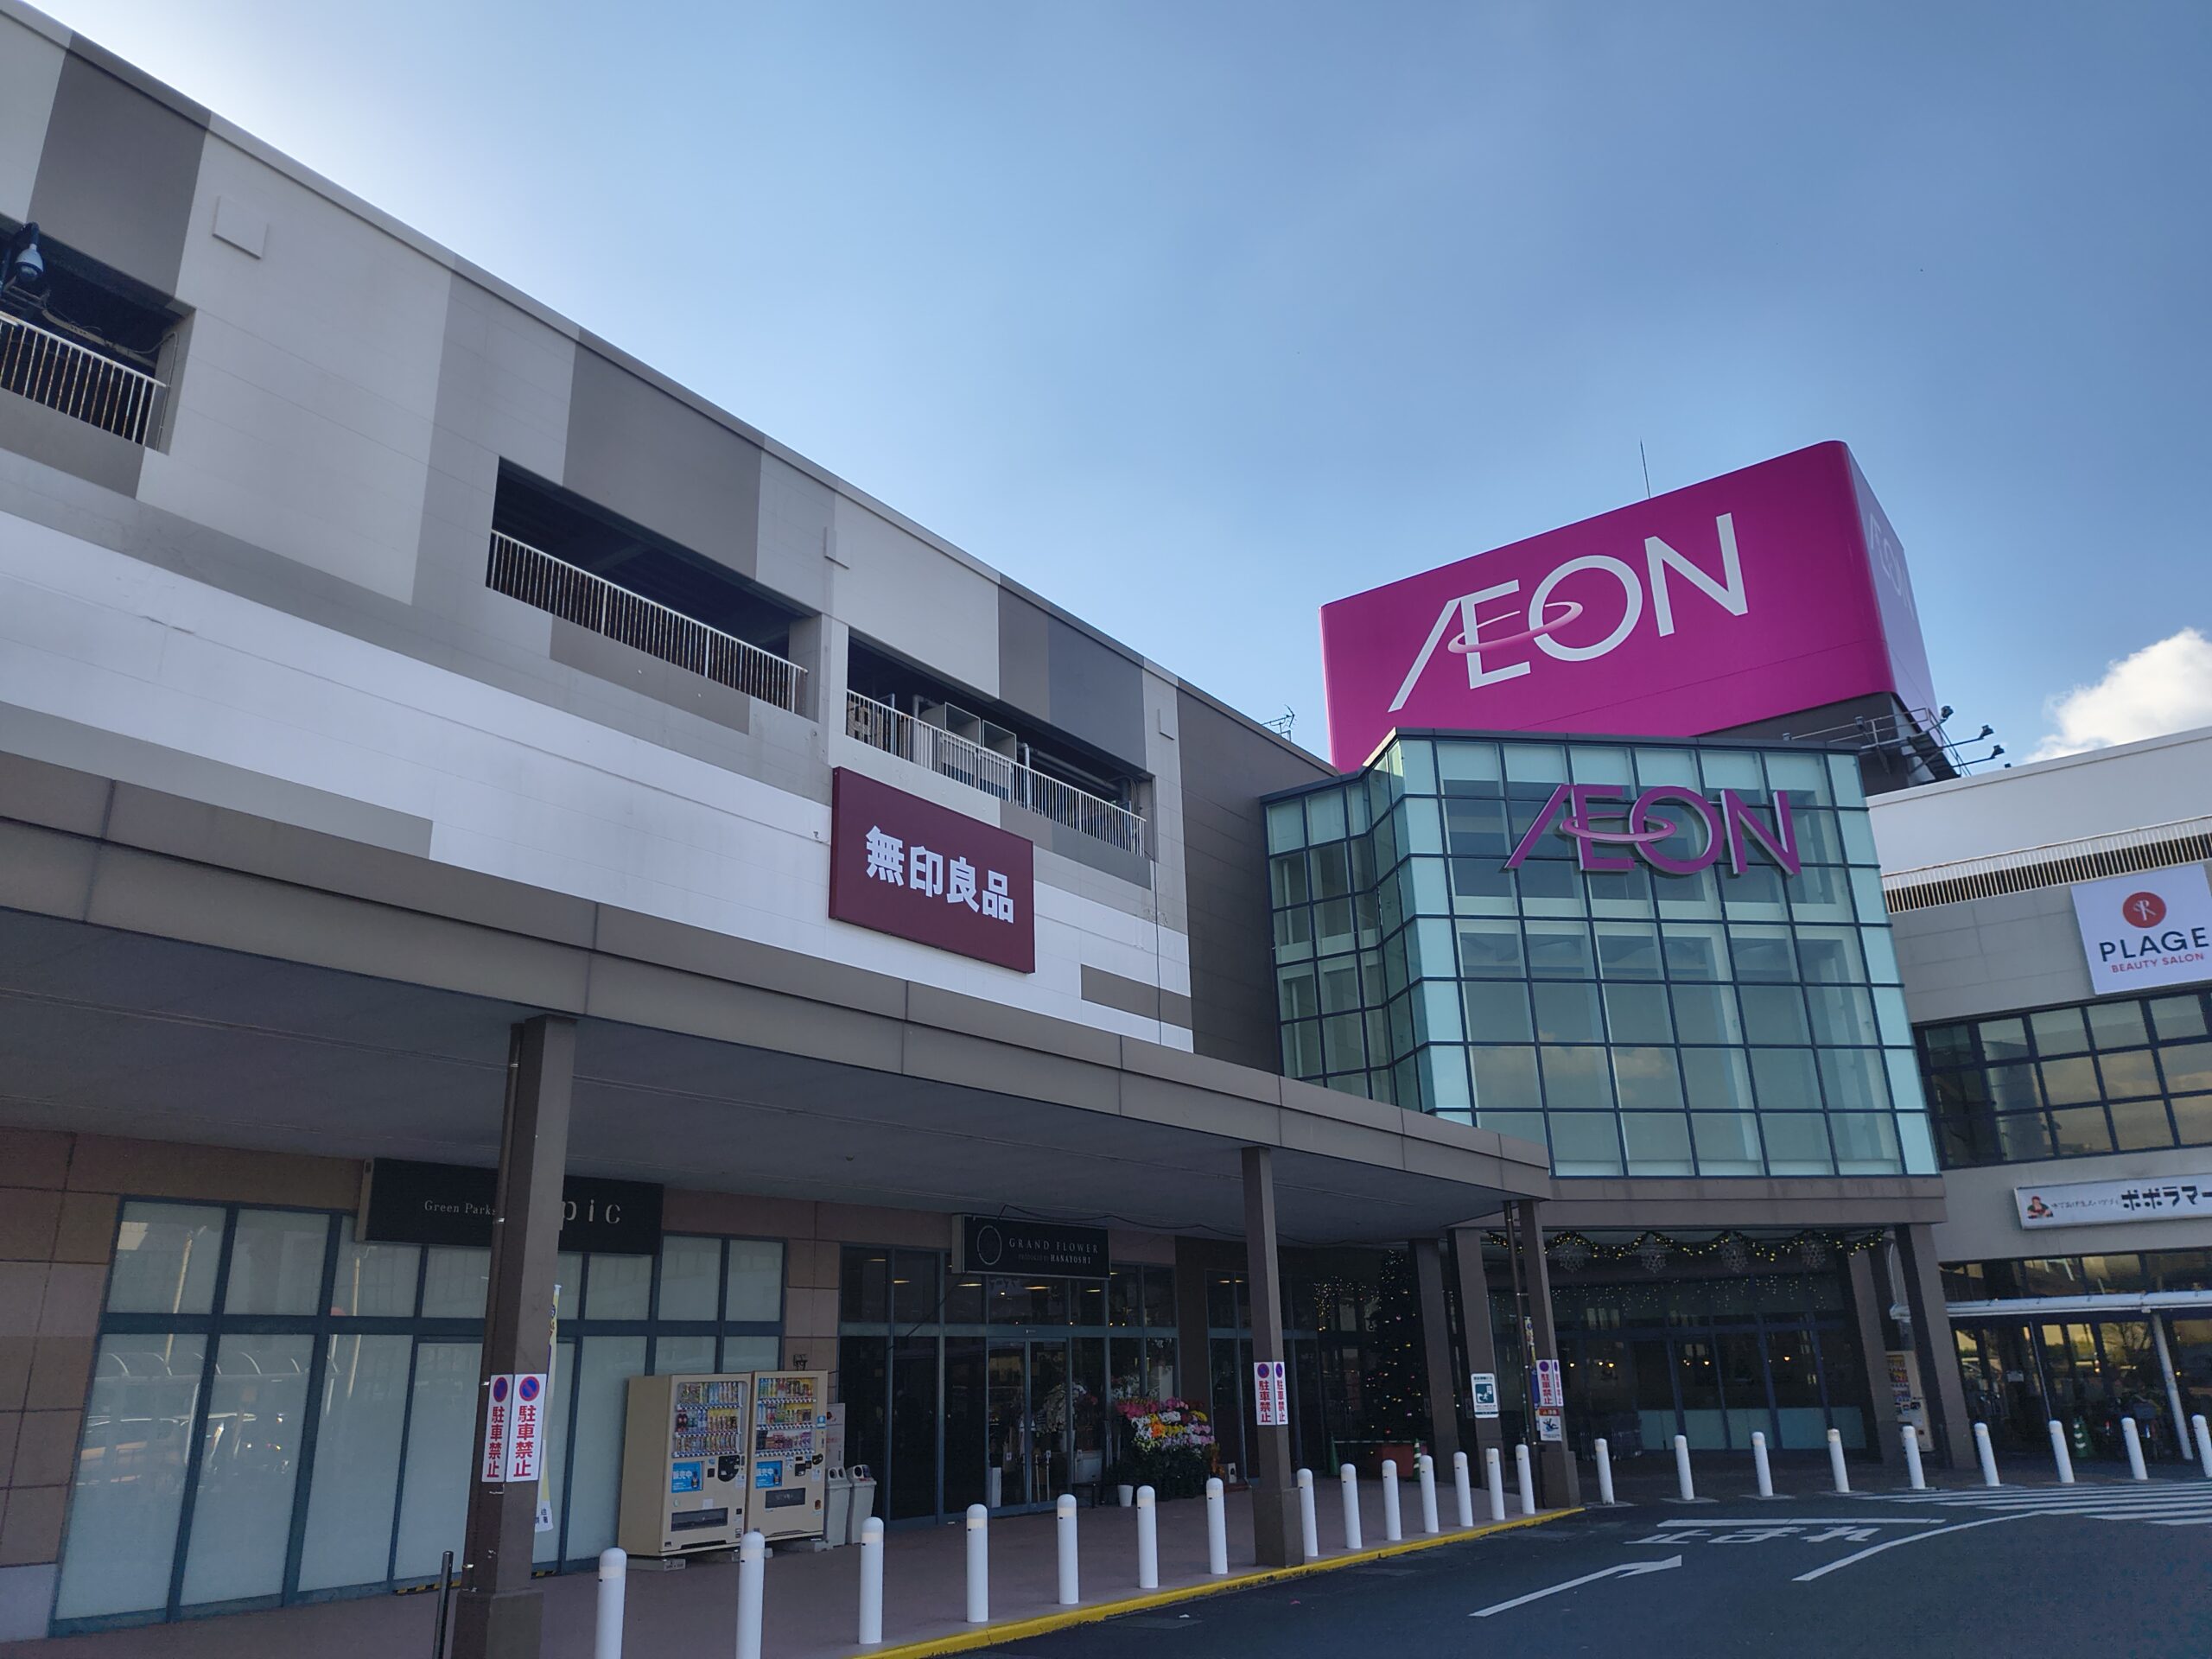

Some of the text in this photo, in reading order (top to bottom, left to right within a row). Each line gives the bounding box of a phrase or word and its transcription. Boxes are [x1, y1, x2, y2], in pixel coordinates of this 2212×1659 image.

[866, 825, 1014, 924] 無印良品
[2099, 927, 2209, 962] PLAGE
[2111, 953, 2205, 973] BEAUTY SALON
[424, 1199, 497, 1216] Green Parks
[1008, 1237, 1099, 1254] GRAND FLOWER
[1050, 1254, 1091, 1265] HANAYOSHI
[1259, 1380, 1271, 1423] 駐車禁止
[1277, 1380, 1286, 1422] 駐車禁止
[486, 1406, 505, 1478] 駐車禁止
[513, 1405, 537, 1478] 駐車禁止
[1623, 1525, 1882, 1545] 止まれ
